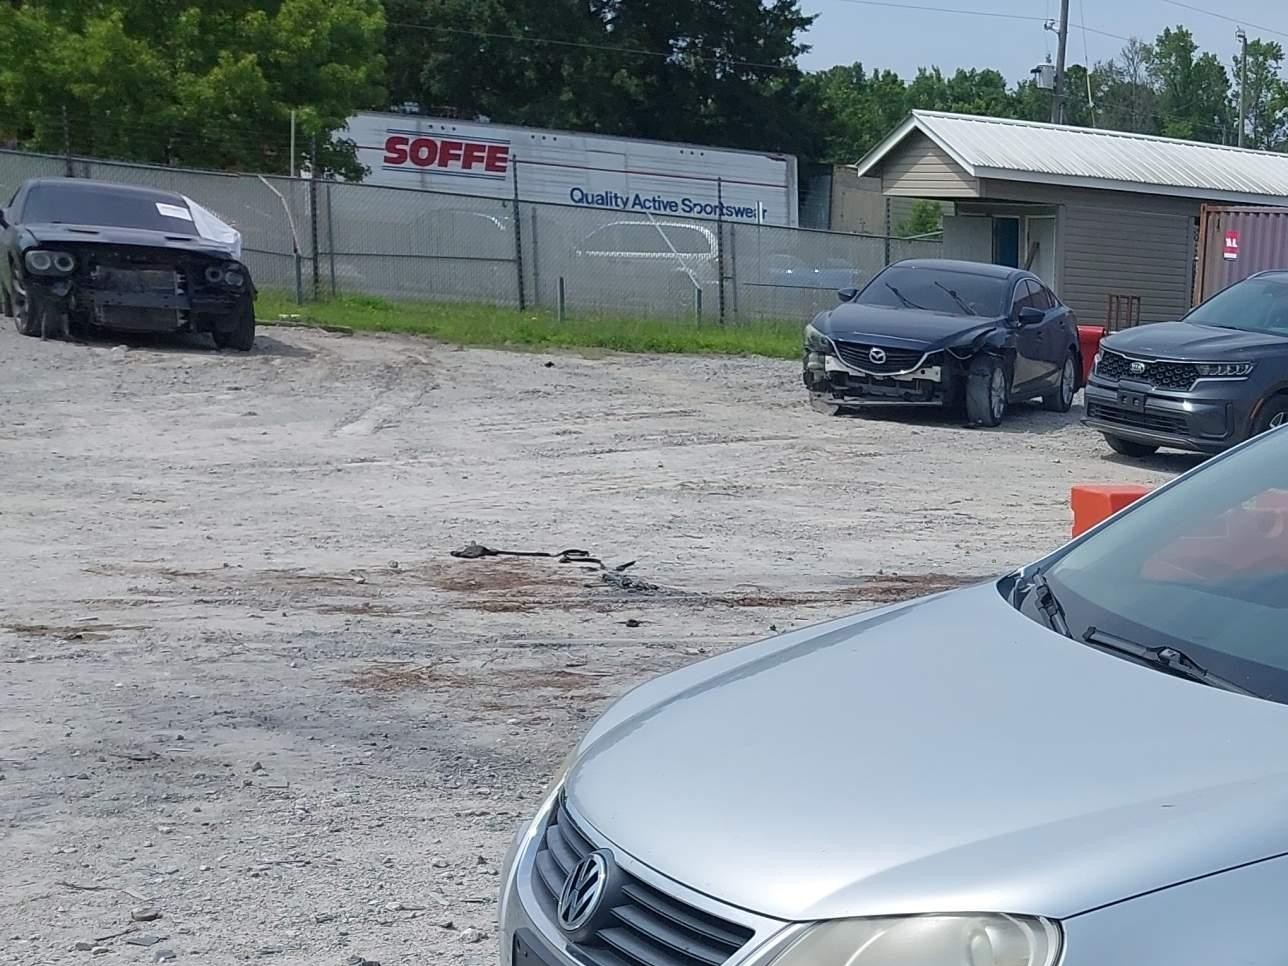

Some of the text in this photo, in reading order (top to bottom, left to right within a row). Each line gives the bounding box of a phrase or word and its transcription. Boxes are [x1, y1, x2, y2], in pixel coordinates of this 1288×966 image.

[383, 136, 509, 173] SOFFE
[569, 187, 630, 210] Quality
[631, 193, 679, 212] Active
